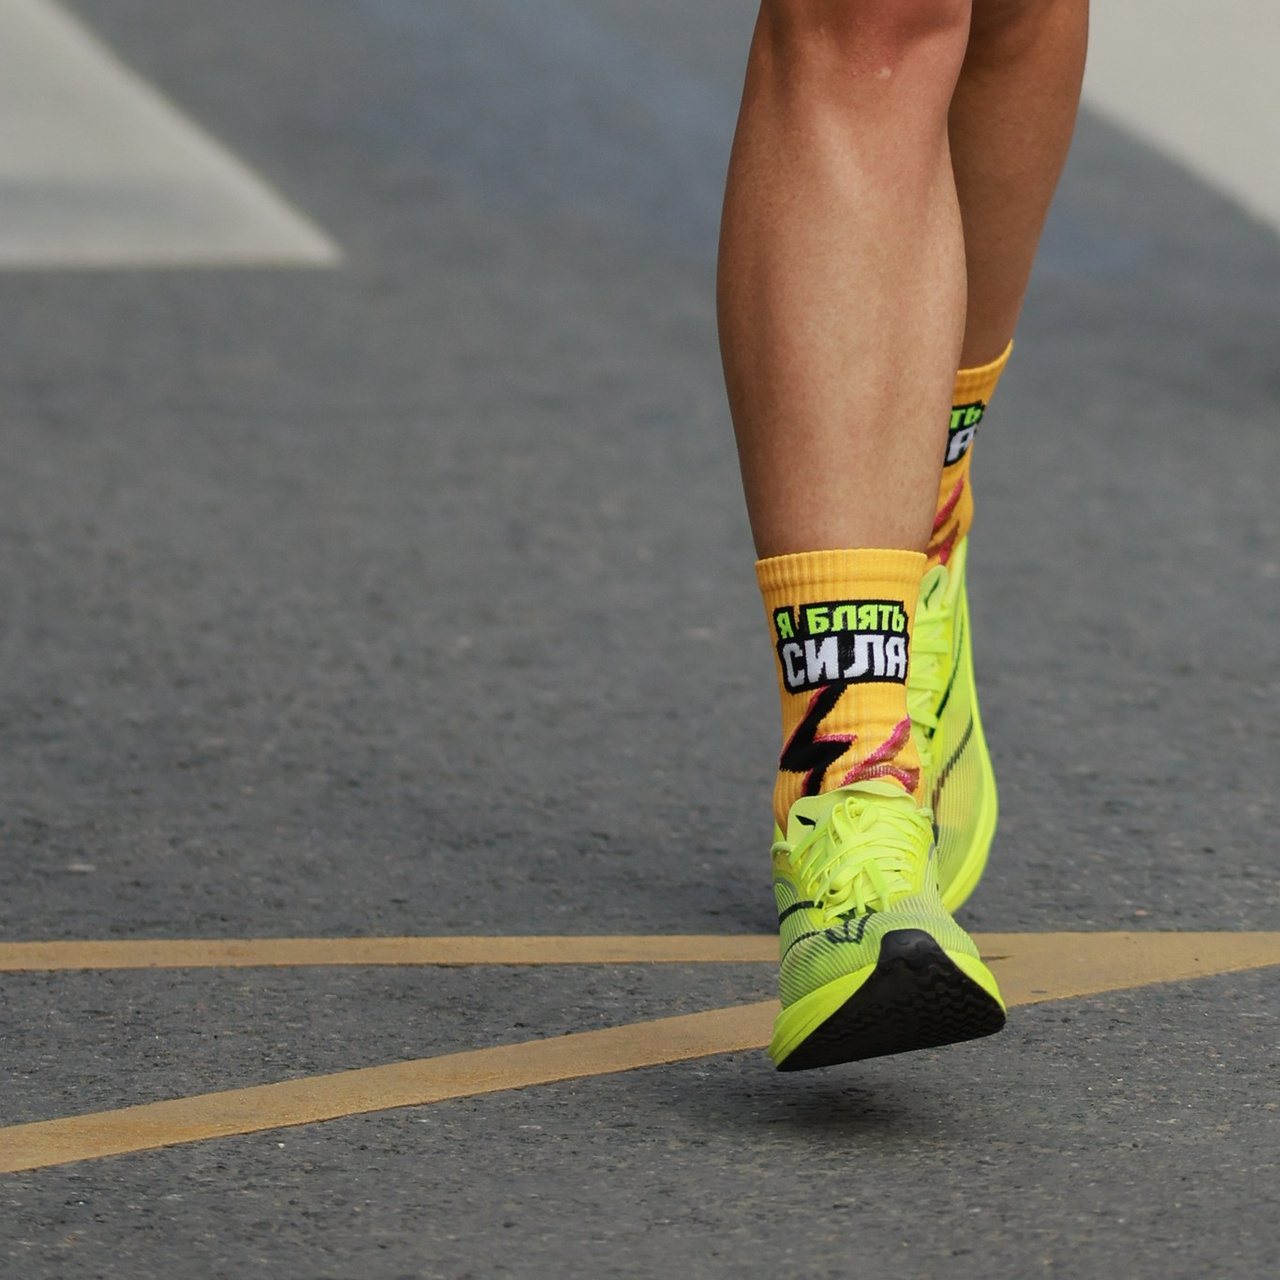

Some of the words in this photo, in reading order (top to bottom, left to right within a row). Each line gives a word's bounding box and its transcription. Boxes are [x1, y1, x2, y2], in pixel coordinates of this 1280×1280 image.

[776, 611, 795, 640] Я
[806, 604, 906, 635] БЛЯТЬ
[782, 634, 908, 688] СИЛА
